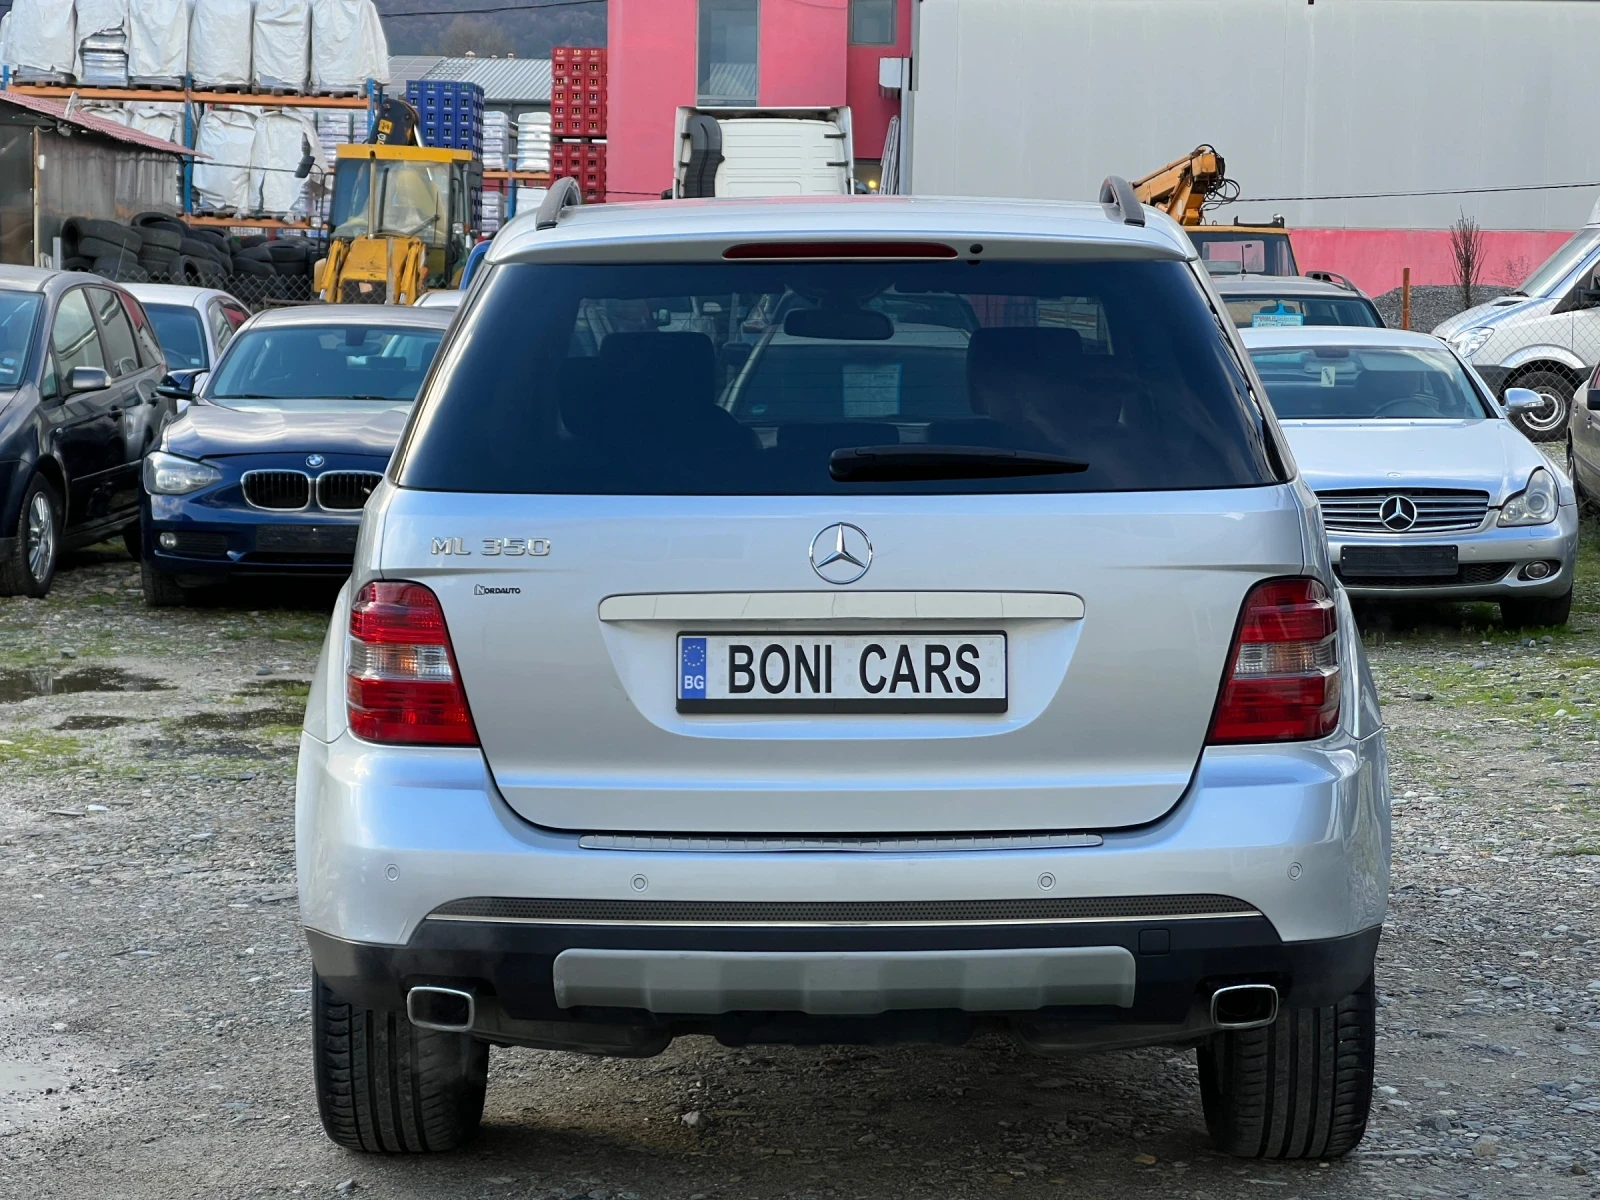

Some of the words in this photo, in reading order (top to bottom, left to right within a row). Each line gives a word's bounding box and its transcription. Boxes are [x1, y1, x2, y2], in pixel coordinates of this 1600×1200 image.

[431, 537, 471, 556] ML
[481, 537, 551, 557] 350
[474, 584, 521, 596] NORDAUTO
[728, 644, 832, 694] BONI
[859, 643, 981, 694] CARS
[684, 675, 705, 690] BG
